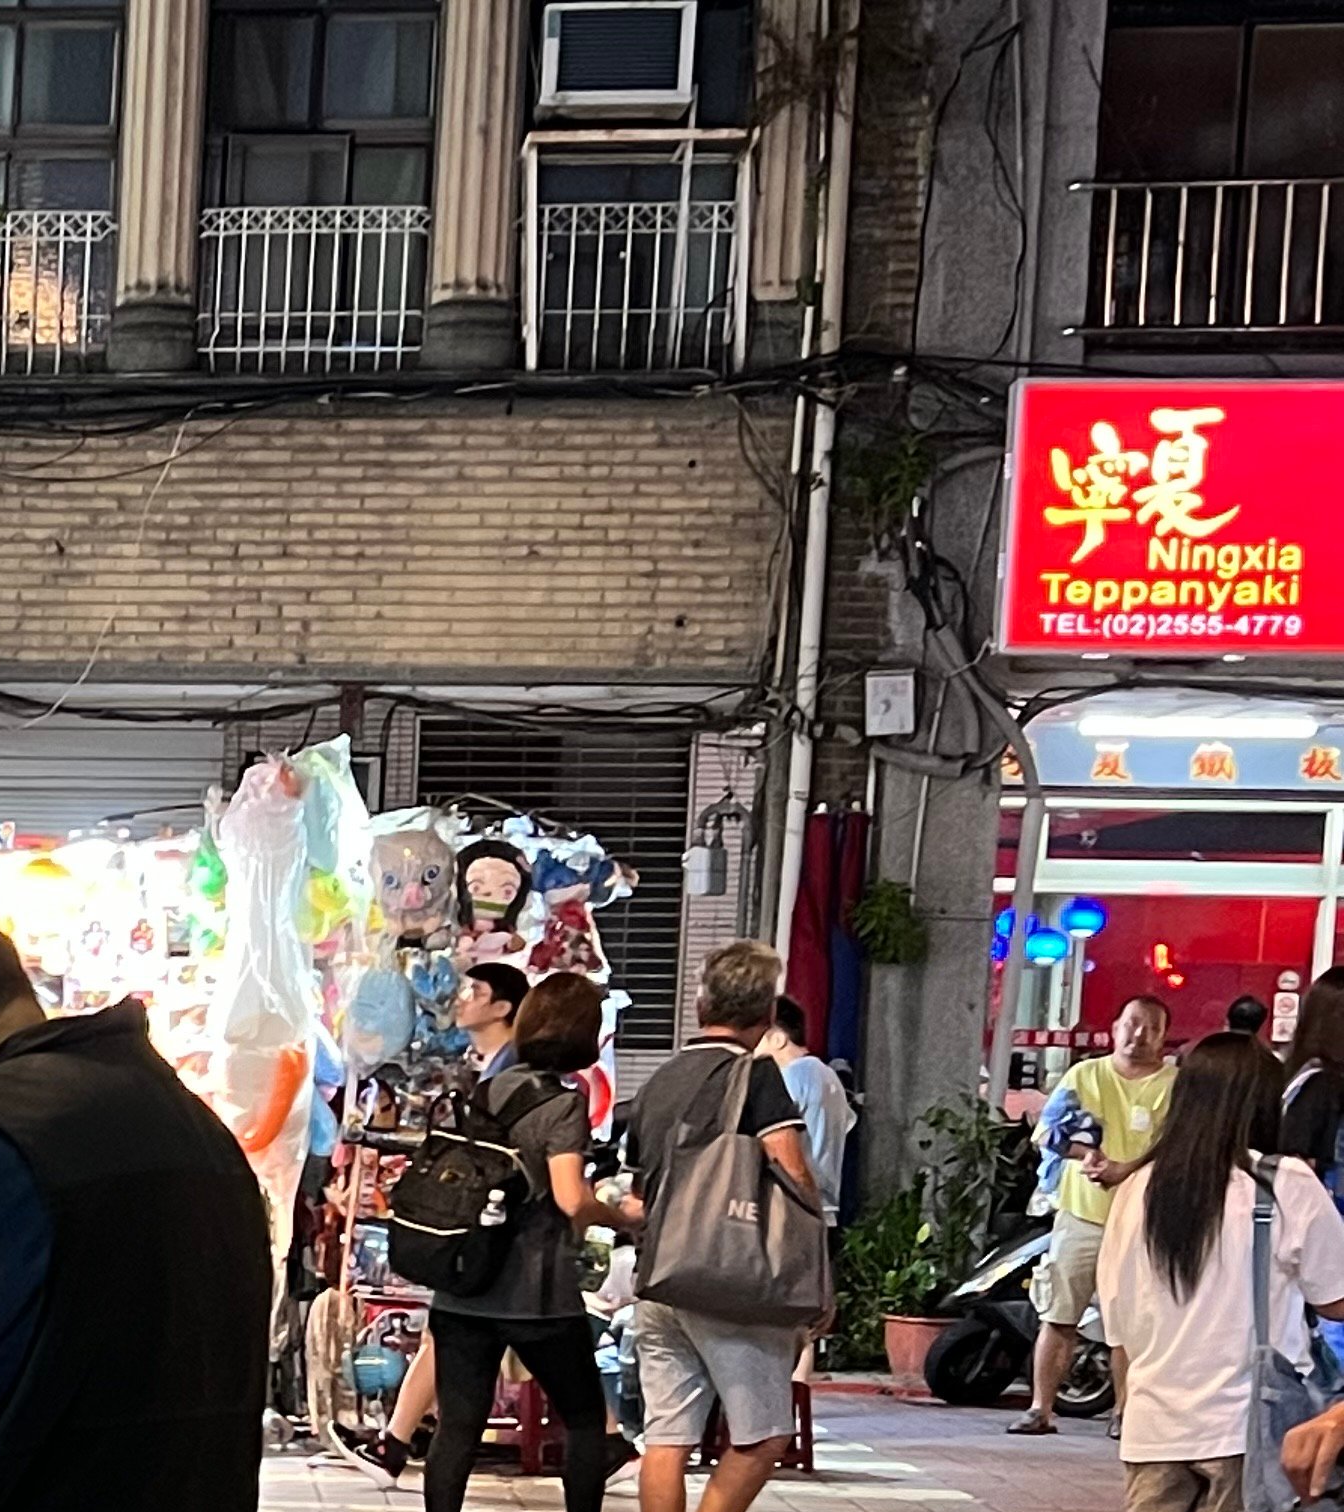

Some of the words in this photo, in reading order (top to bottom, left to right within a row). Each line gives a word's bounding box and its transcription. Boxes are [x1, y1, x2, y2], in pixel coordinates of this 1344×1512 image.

[1043, 407, 1240, 563] 寧夏
[1148, 537, 1302, 578] Ningxia
[1041, 573, 1301, 612] Teppanyaki
[1040, 613, 1303, 638] TEL:(02)2555-4779
